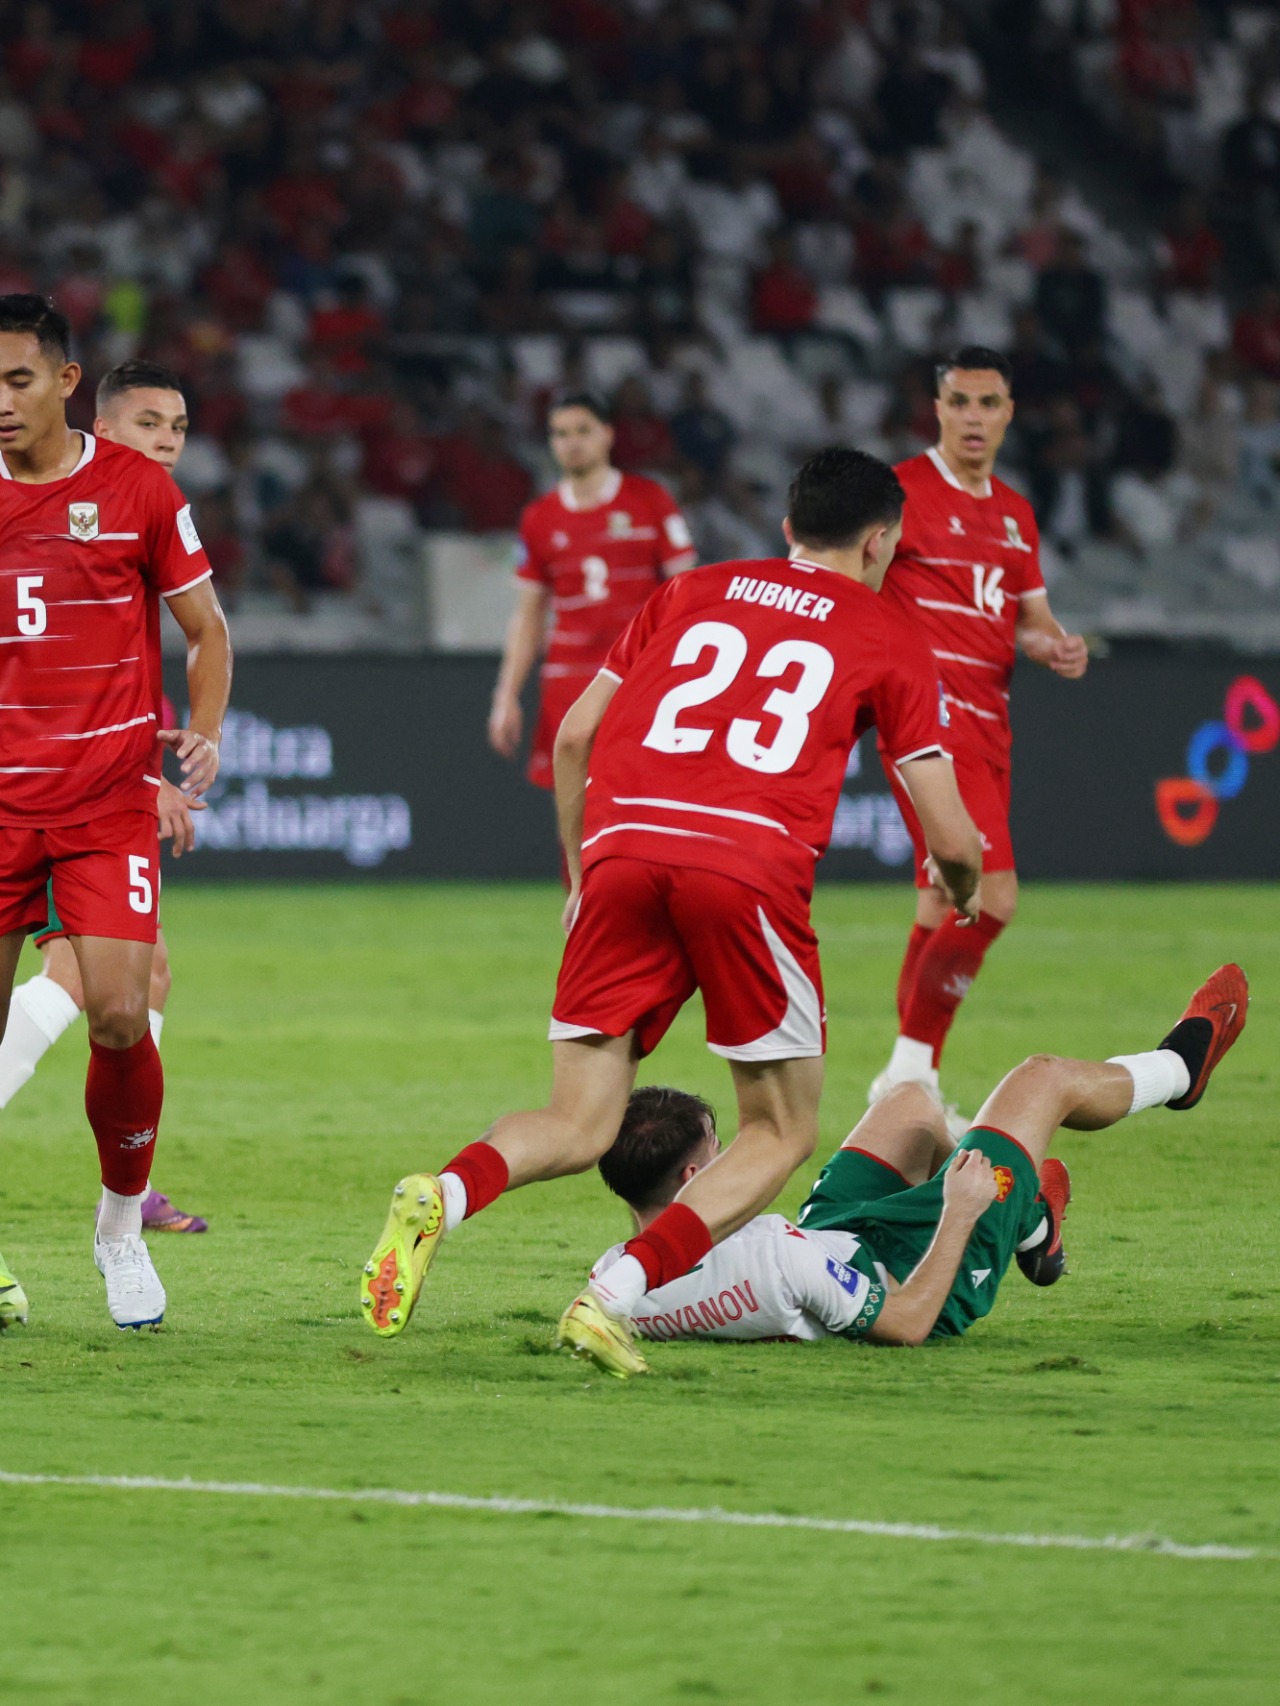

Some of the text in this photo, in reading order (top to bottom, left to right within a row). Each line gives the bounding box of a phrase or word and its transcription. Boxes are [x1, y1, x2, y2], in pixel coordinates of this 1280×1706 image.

[17, 576, 47, 635] 5
[724, 576, 835, 622] HUBNER
[972, 563, 1005, 616] 14
[641, 621, 835, 774] 23
[128, 854, 153, 914] 5
